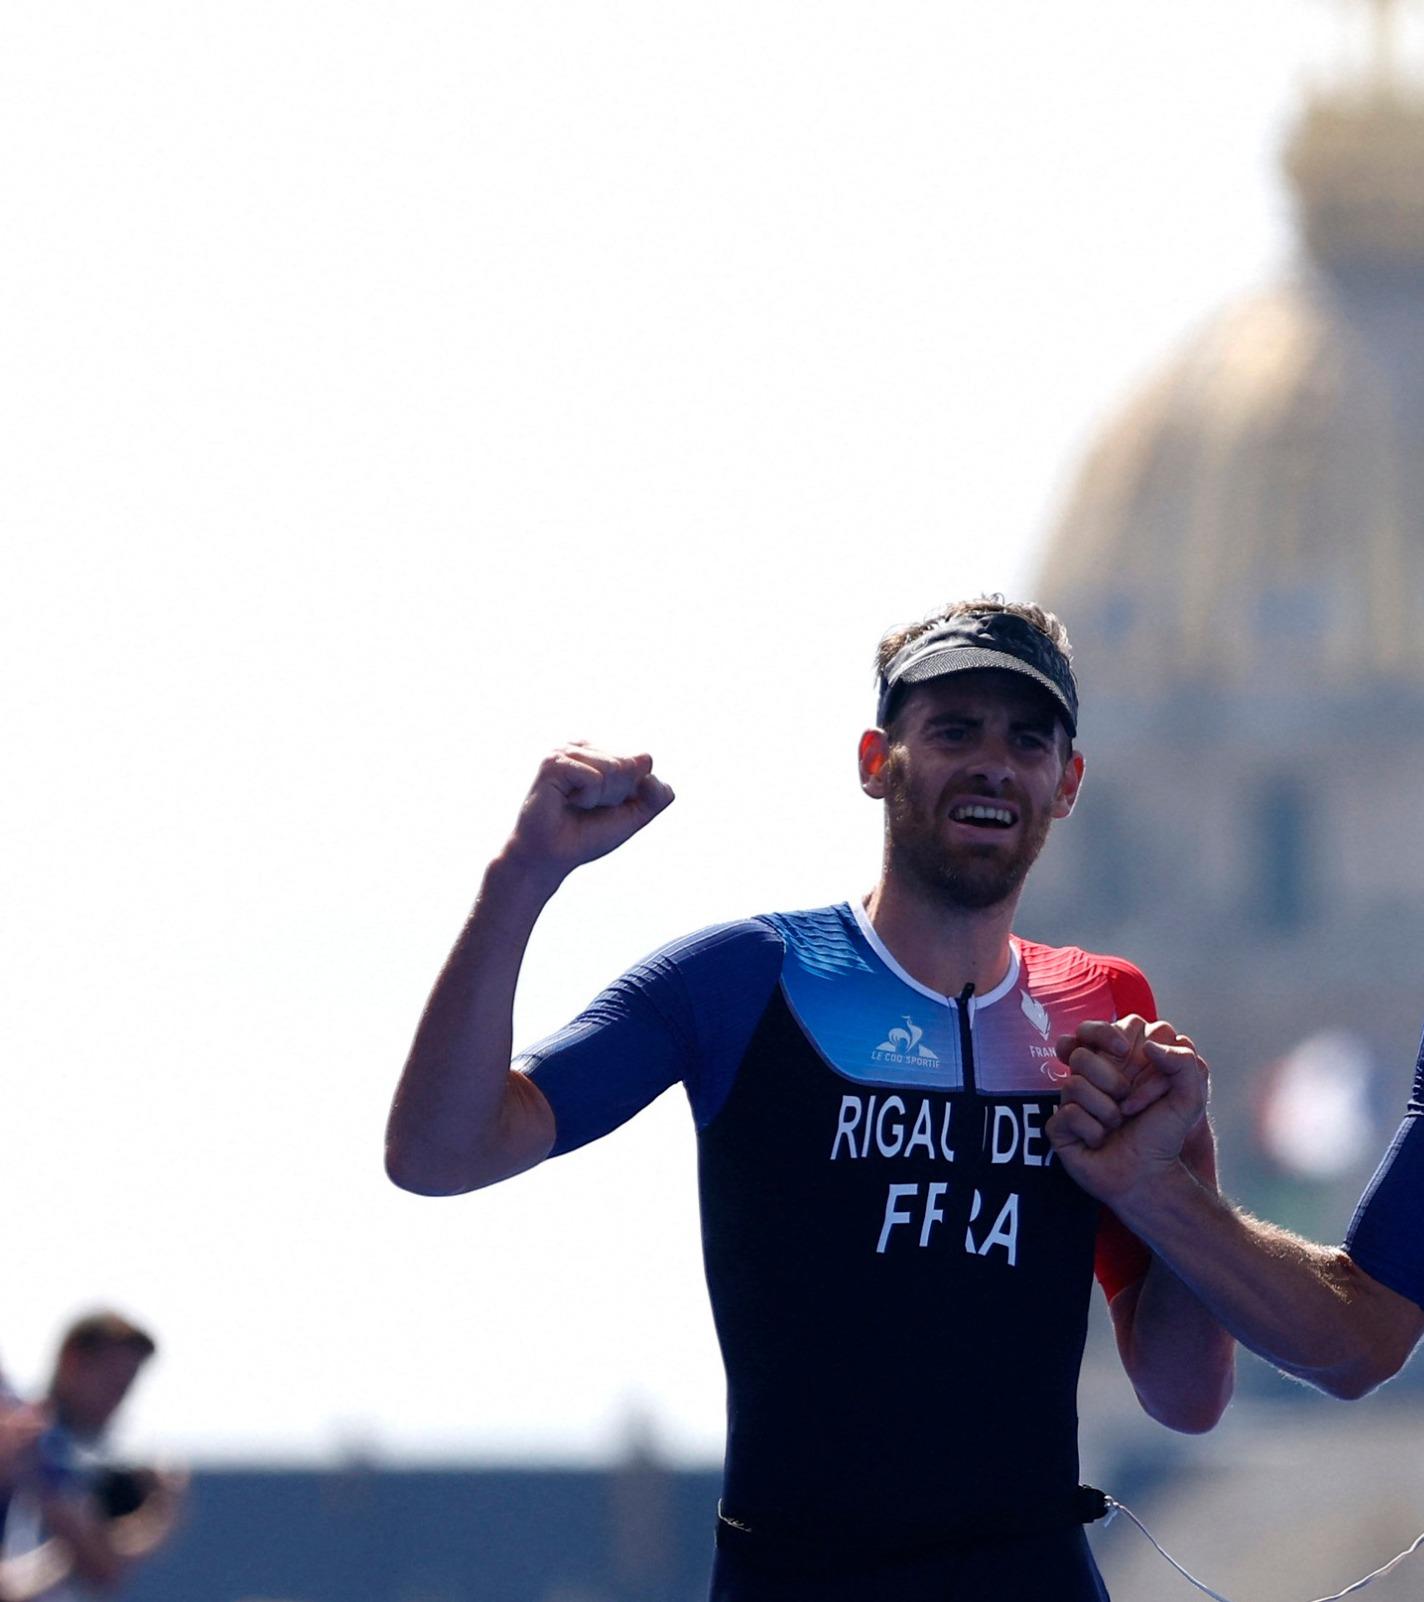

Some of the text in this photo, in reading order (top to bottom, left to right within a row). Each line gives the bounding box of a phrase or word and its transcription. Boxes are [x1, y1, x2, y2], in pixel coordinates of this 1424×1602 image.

[1029, 1045, 1057, 1058] FRAN
[871, 1051, 882, 1060] LE
[904, 1055, 940, 1069] SPORTIF
